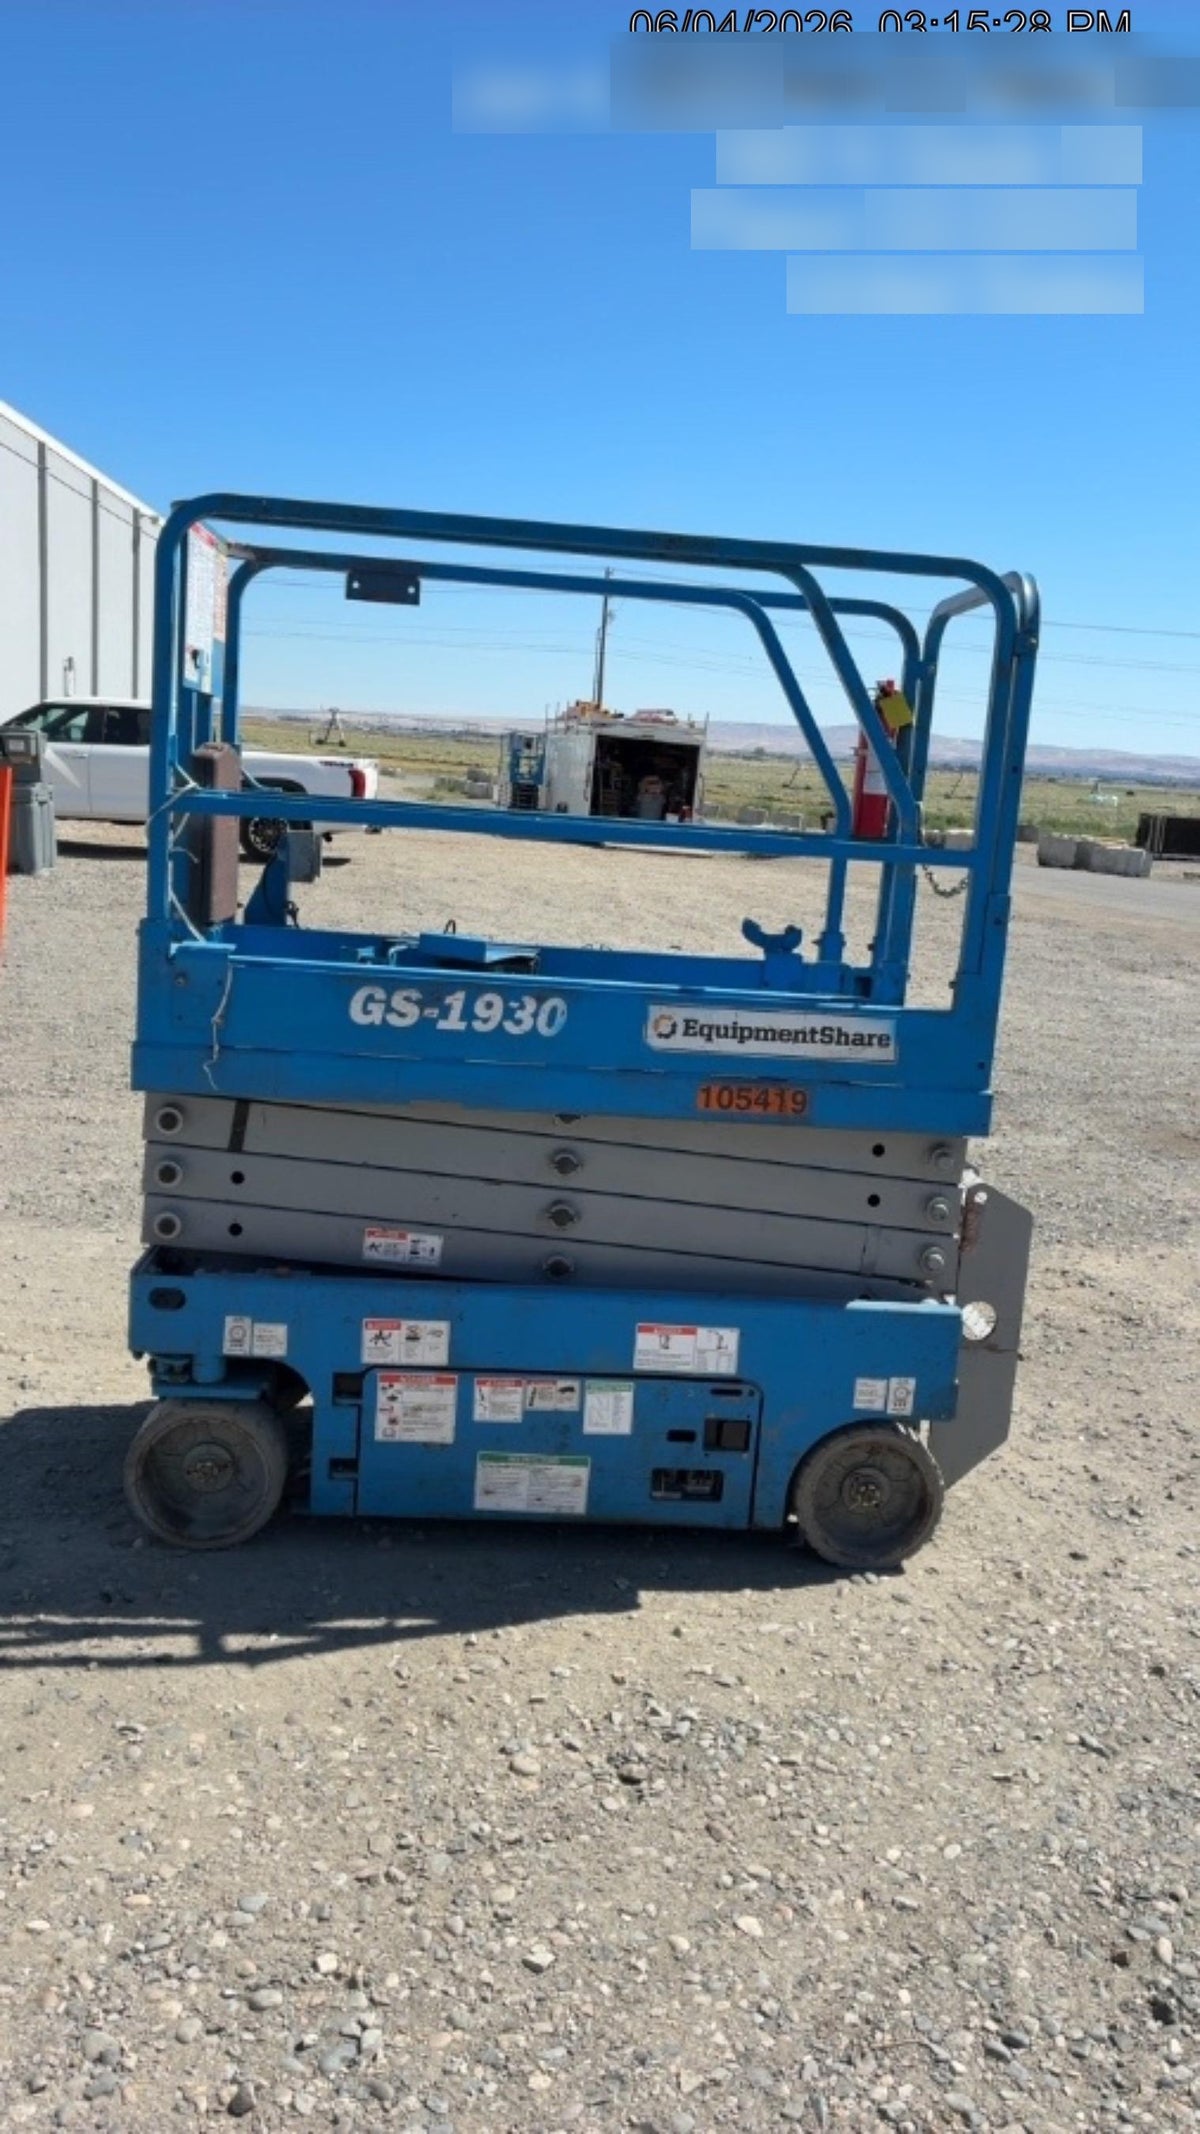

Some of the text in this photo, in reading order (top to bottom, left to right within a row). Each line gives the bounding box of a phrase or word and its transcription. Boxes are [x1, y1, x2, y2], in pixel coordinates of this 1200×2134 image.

[349, 985, 568, 1036] GS-1930
[682, 1018, 892, 1048] EquipmentShare
[700, 1085, 808, 1114] 105419
